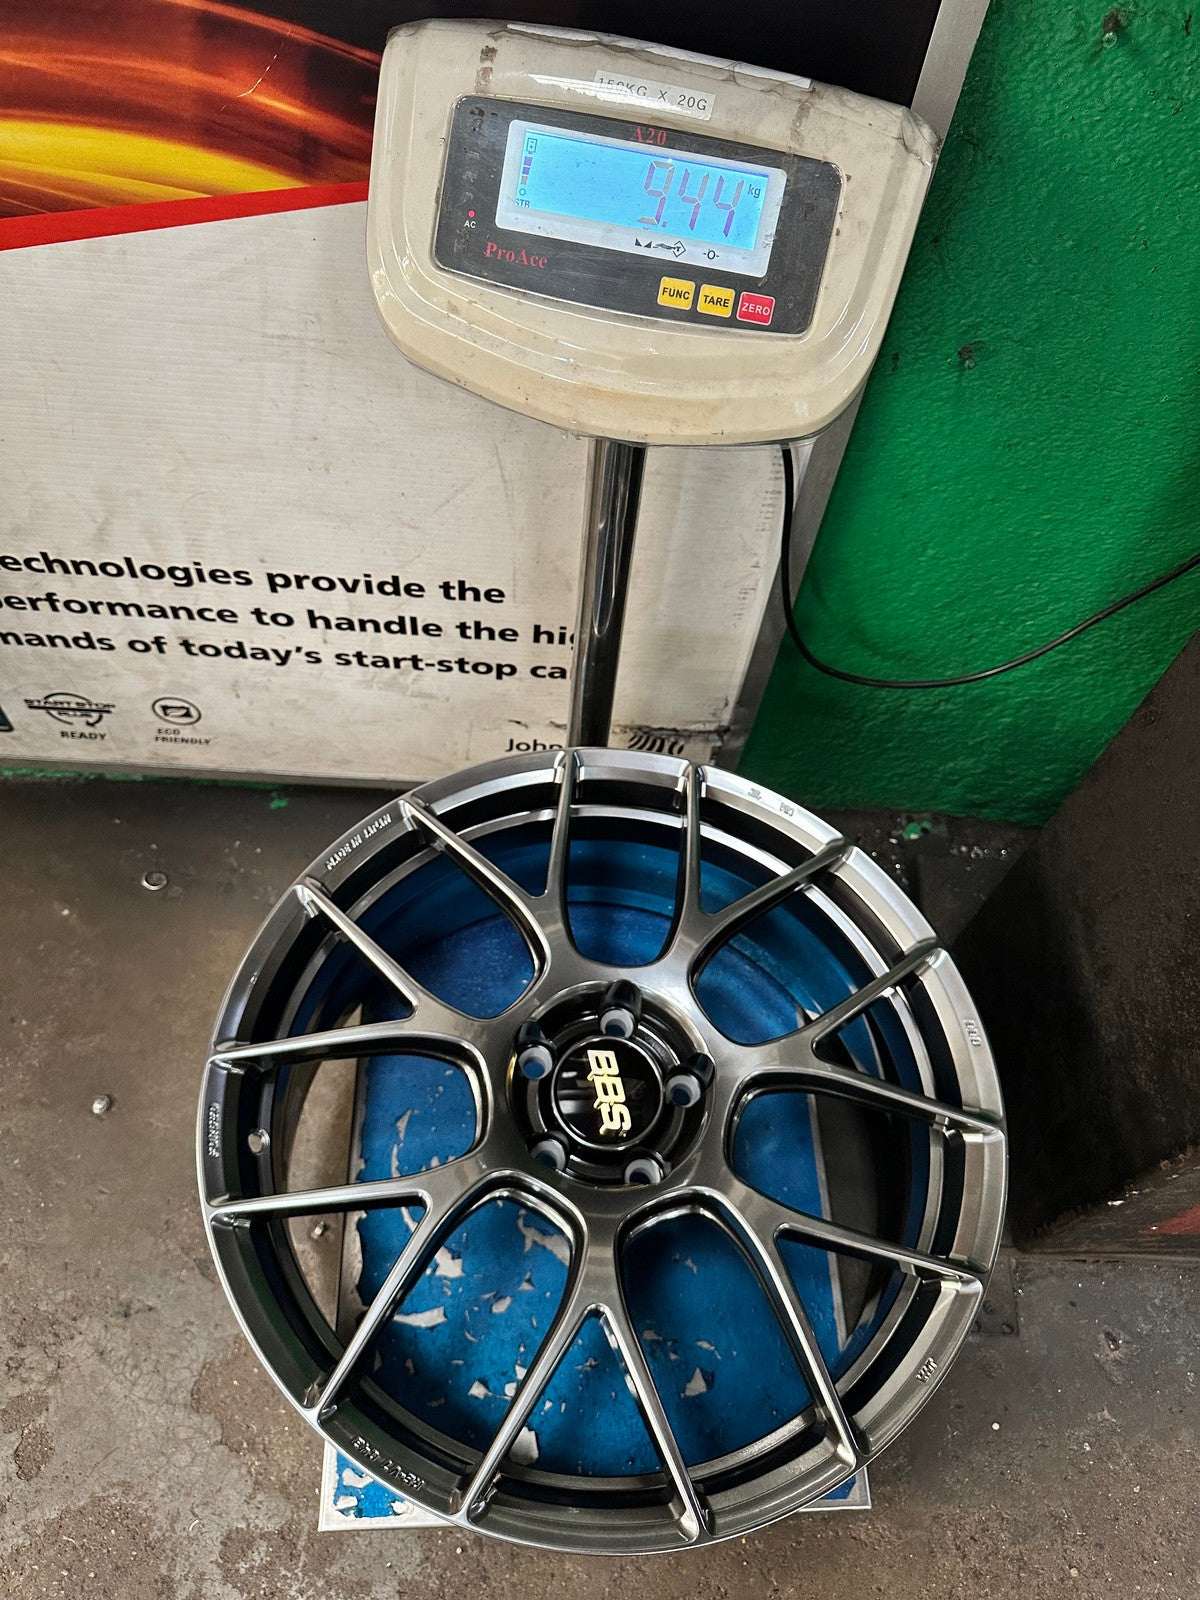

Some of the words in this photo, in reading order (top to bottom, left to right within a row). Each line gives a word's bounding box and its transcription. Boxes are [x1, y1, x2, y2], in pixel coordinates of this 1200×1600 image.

[657, 89, 668, 103] X
[677, 94, 708, 111] 20G
[632, 127, 667, 145] A20
[637, 160, 744, 238] 9.44
[747, 184, 761, 199] kg
[463, 219, 477, 229] AC
[484, 241, 548, 269] ProAce
[661, 286, 690, 300] FUNC
[703, 294, 731, 308] TARE
[741, 302, 771, 316] ZERO
[0, 551, 253, 587] echnologies
[266, 571, 426, 598] provide
[438, 579, 506, 604] the
[0, 592, 239, 624] erformance
[251, 607, 294, 627] to
[306, 609, 443, 637] handle
[455, 620, 519, 642] the
[533, 624, 575, 650] hi
[128, 635, 168, 654] of
[180, 638, 322, 666] today's
[335, 649, 518, 680] start-stop
[61, 730, 107, 741] READY
[154, 736, 211, 746] FRIENDLY
[157, 728, 181, 736] ECO
[586, 1049, 632, 1136] BBS
